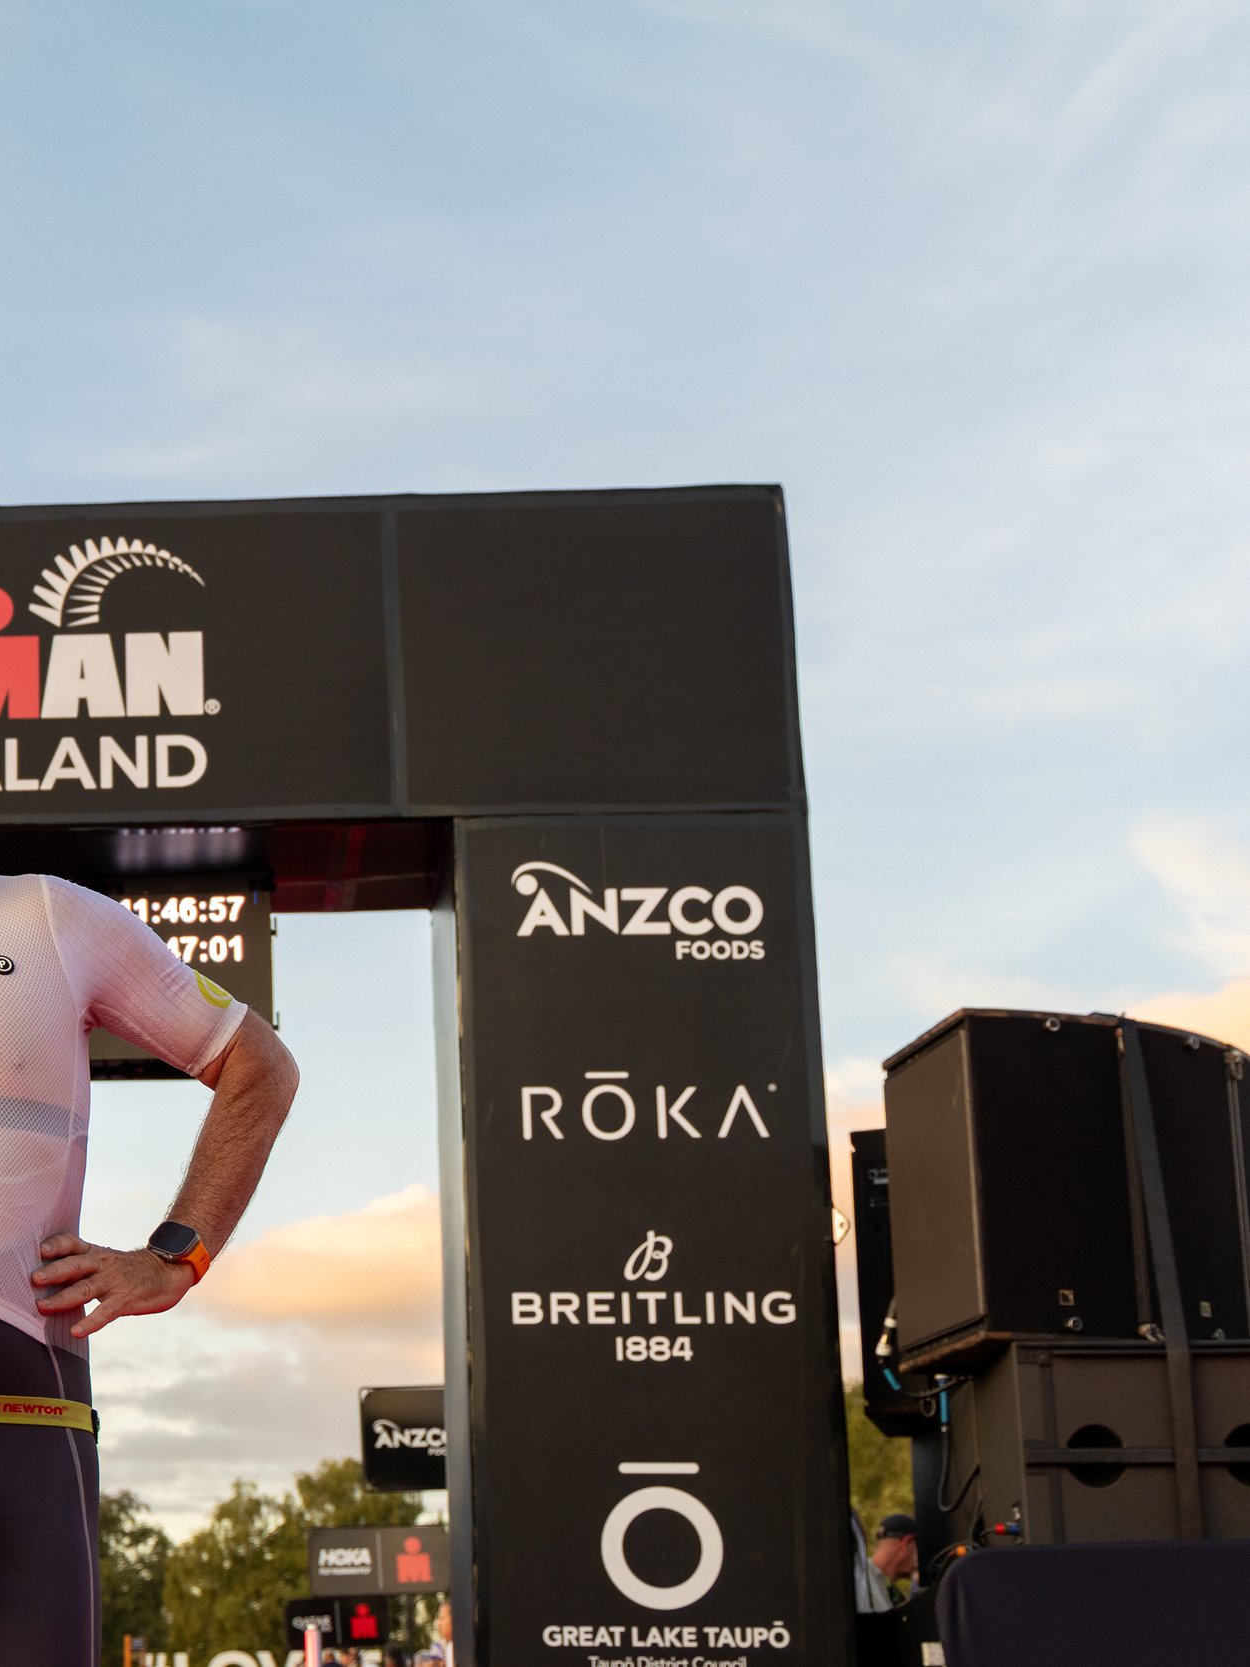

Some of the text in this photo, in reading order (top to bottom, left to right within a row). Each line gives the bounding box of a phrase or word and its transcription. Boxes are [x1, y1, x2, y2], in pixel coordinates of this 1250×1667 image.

[511, 872, 764, 937] ANZCO
[675, 940, 766, 961] FOODS
[510, 1291, 797, 1325] BREITLING
[615, 1335, 694, 1362] 1884
[373, 1423, 448, 1449] ANZC
[541, 1620, 791, 1649] GREAT LAKE TAUPŌ
